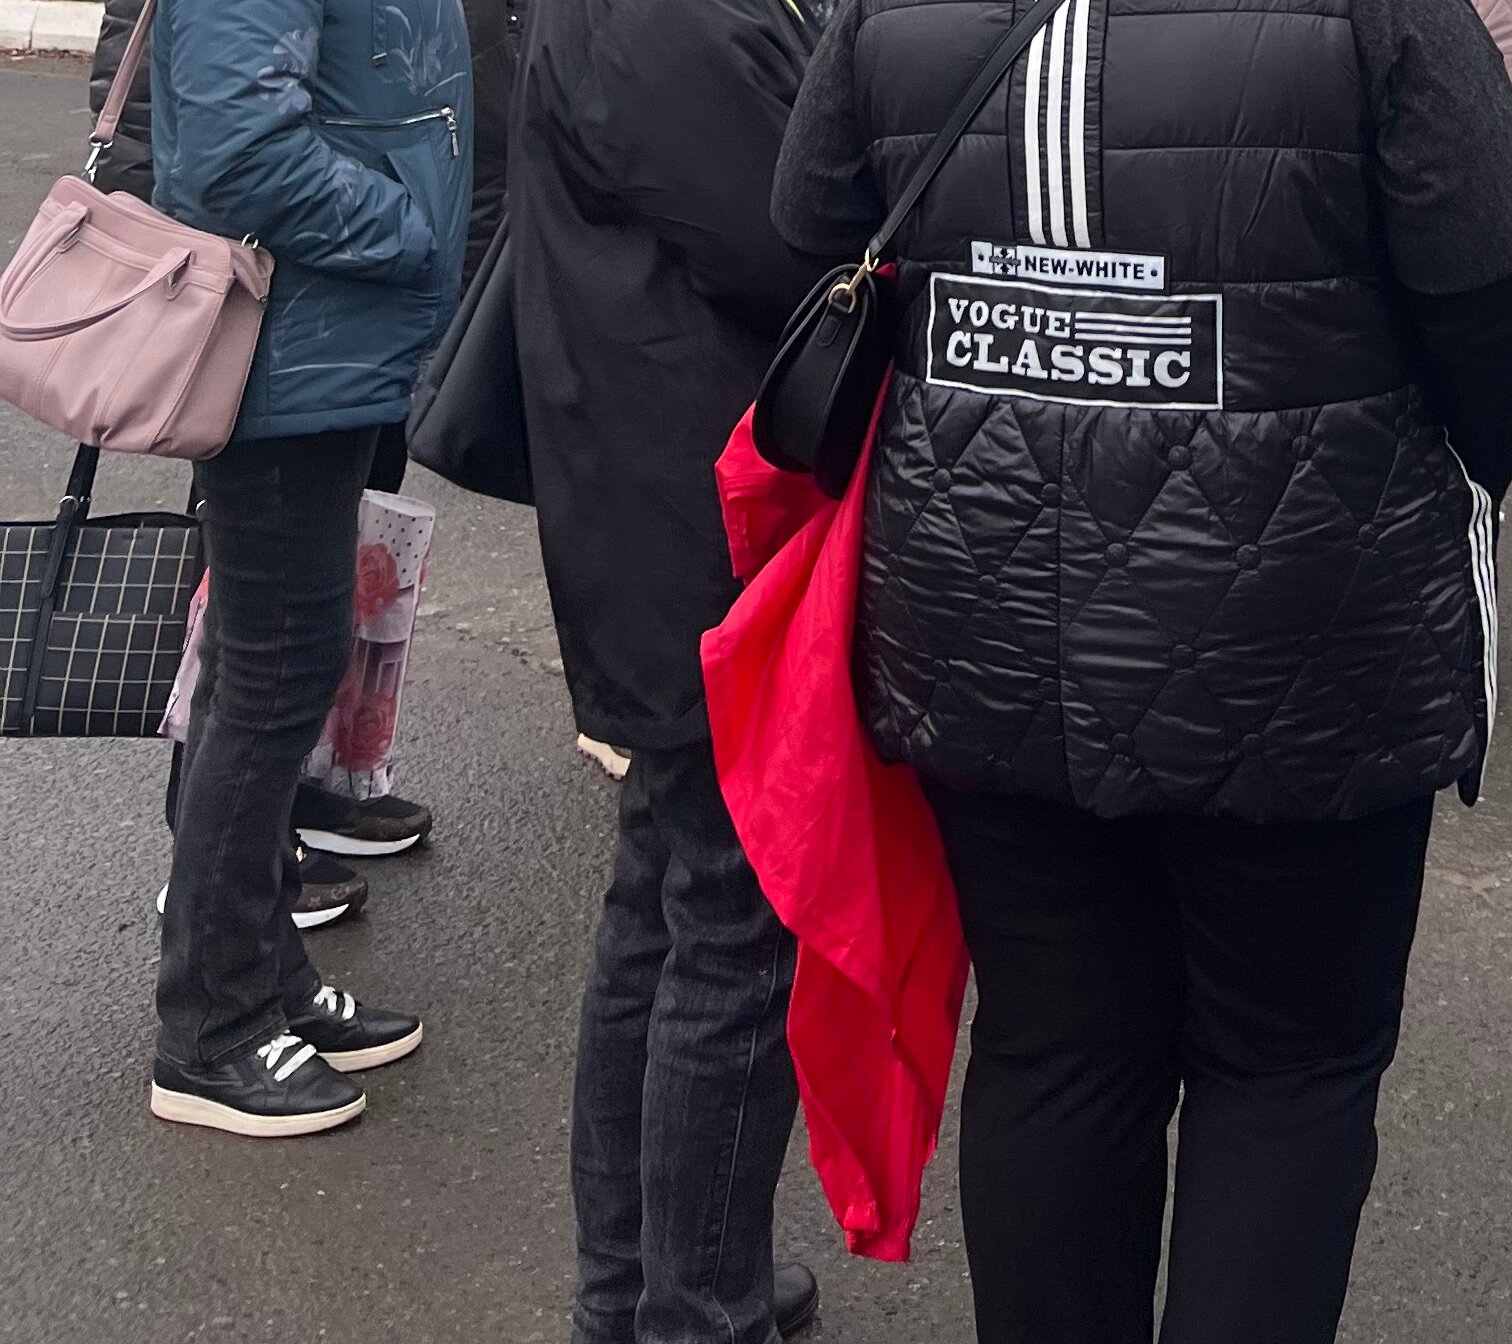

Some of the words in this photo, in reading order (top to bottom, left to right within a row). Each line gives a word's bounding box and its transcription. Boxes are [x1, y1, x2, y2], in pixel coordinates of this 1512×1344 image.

[1024, 255, 1145, 280] NEW-WHITE
[948, 298, 1072, 338] VOGUE
[946, 331, 1191, 388] CLASSIC
